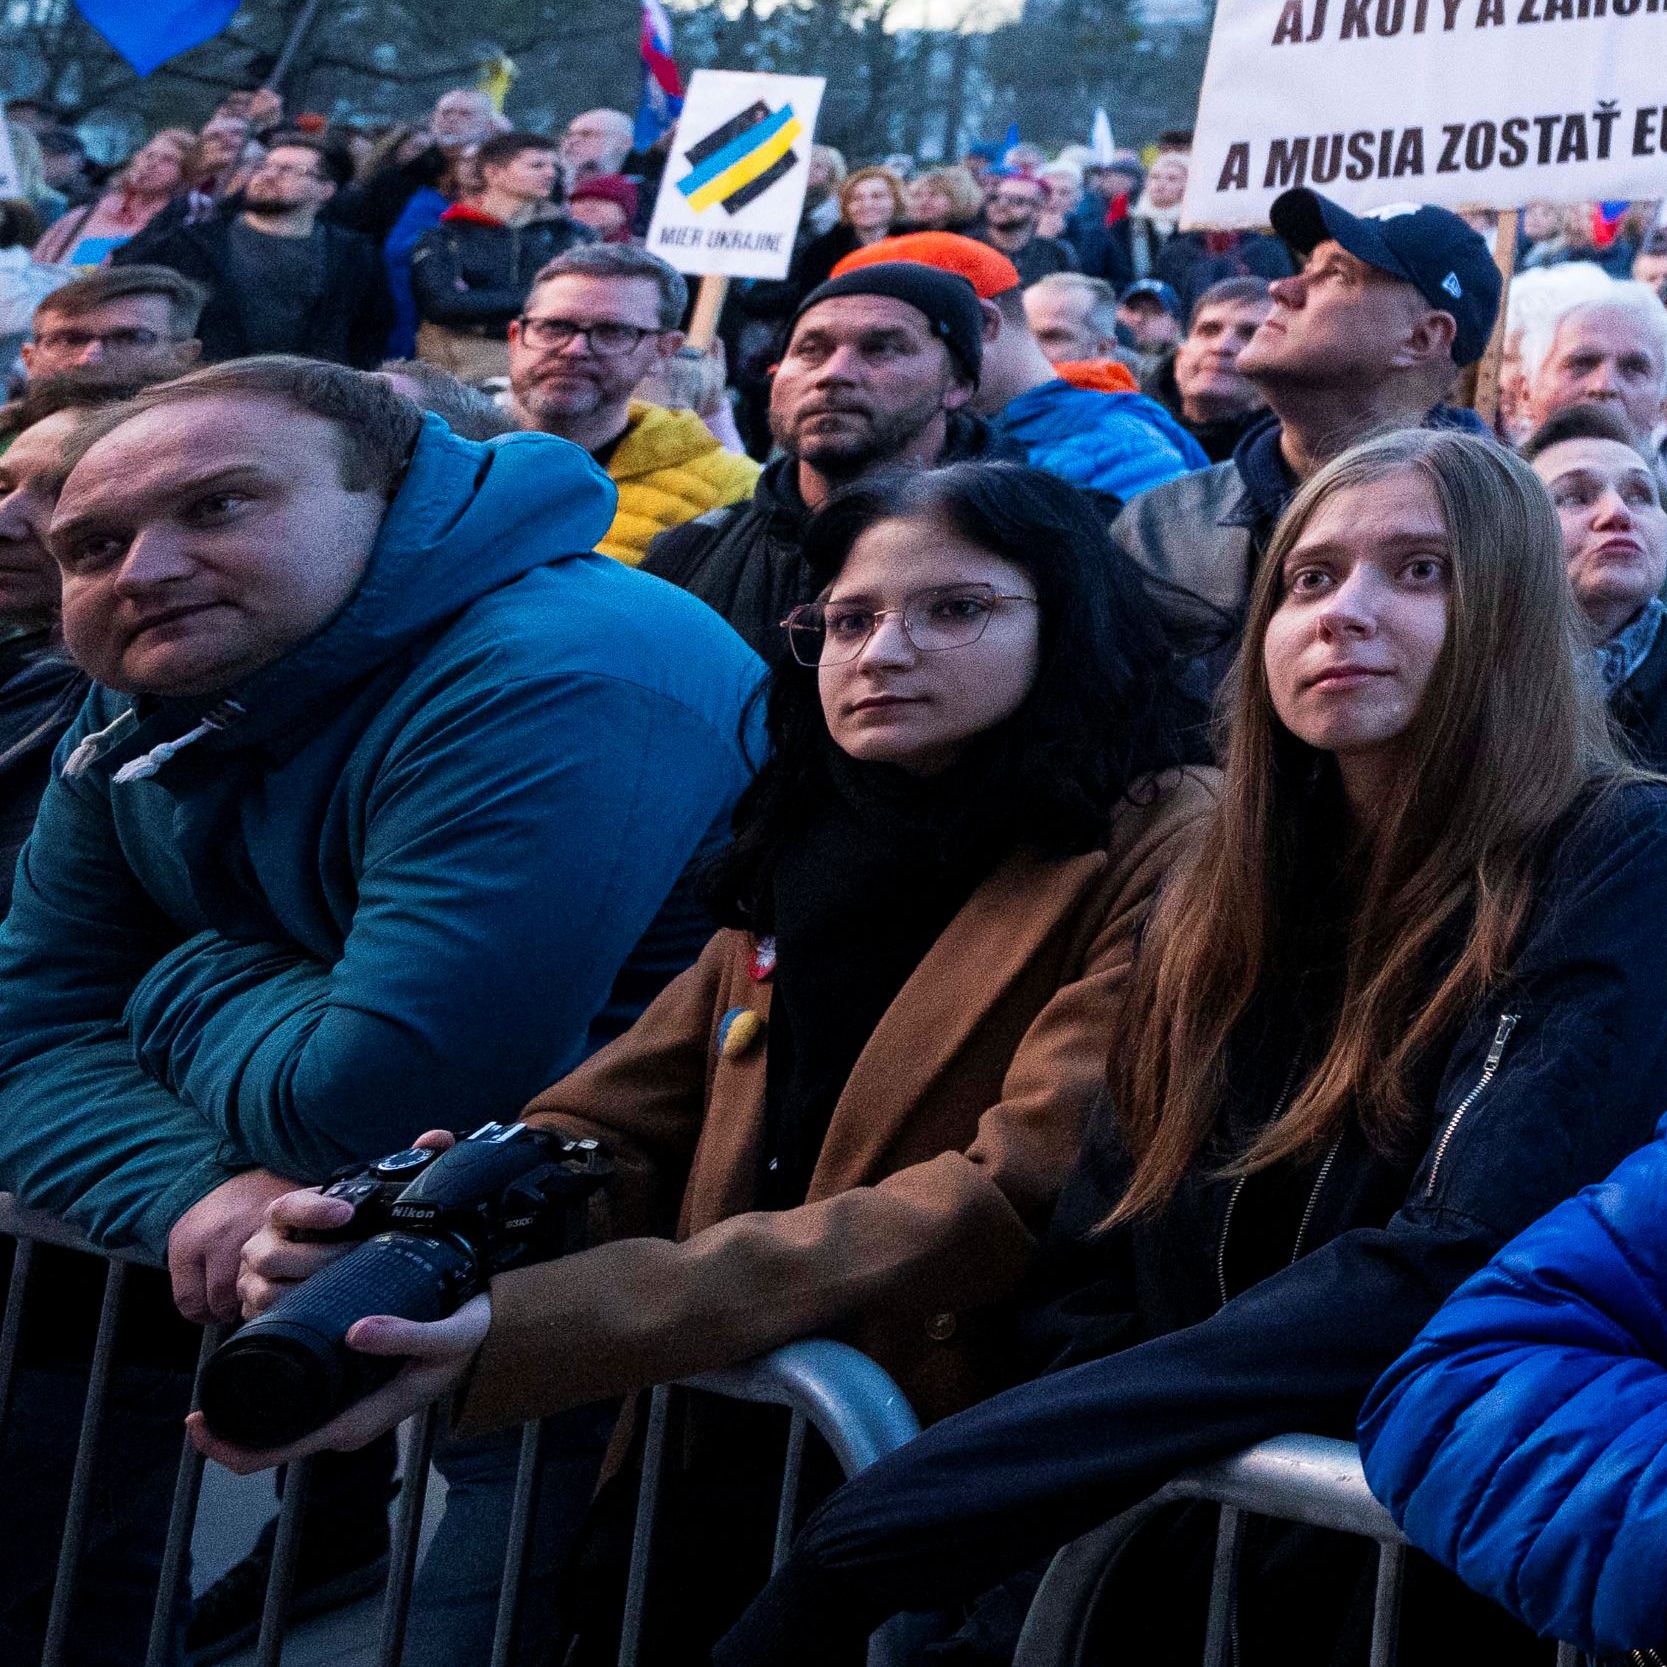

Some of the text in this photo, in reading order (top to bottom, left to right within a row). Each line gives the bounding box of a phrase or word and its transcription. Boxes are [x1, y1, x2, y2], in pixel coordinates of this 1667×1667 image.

[1217, 142, 1250, 192] A
[1264, 128, 1423, 190] MUSIA
[1437, 99, 1621, 174] ZOSTAŤ
[391, 1206, 435, 1219] Nikon
